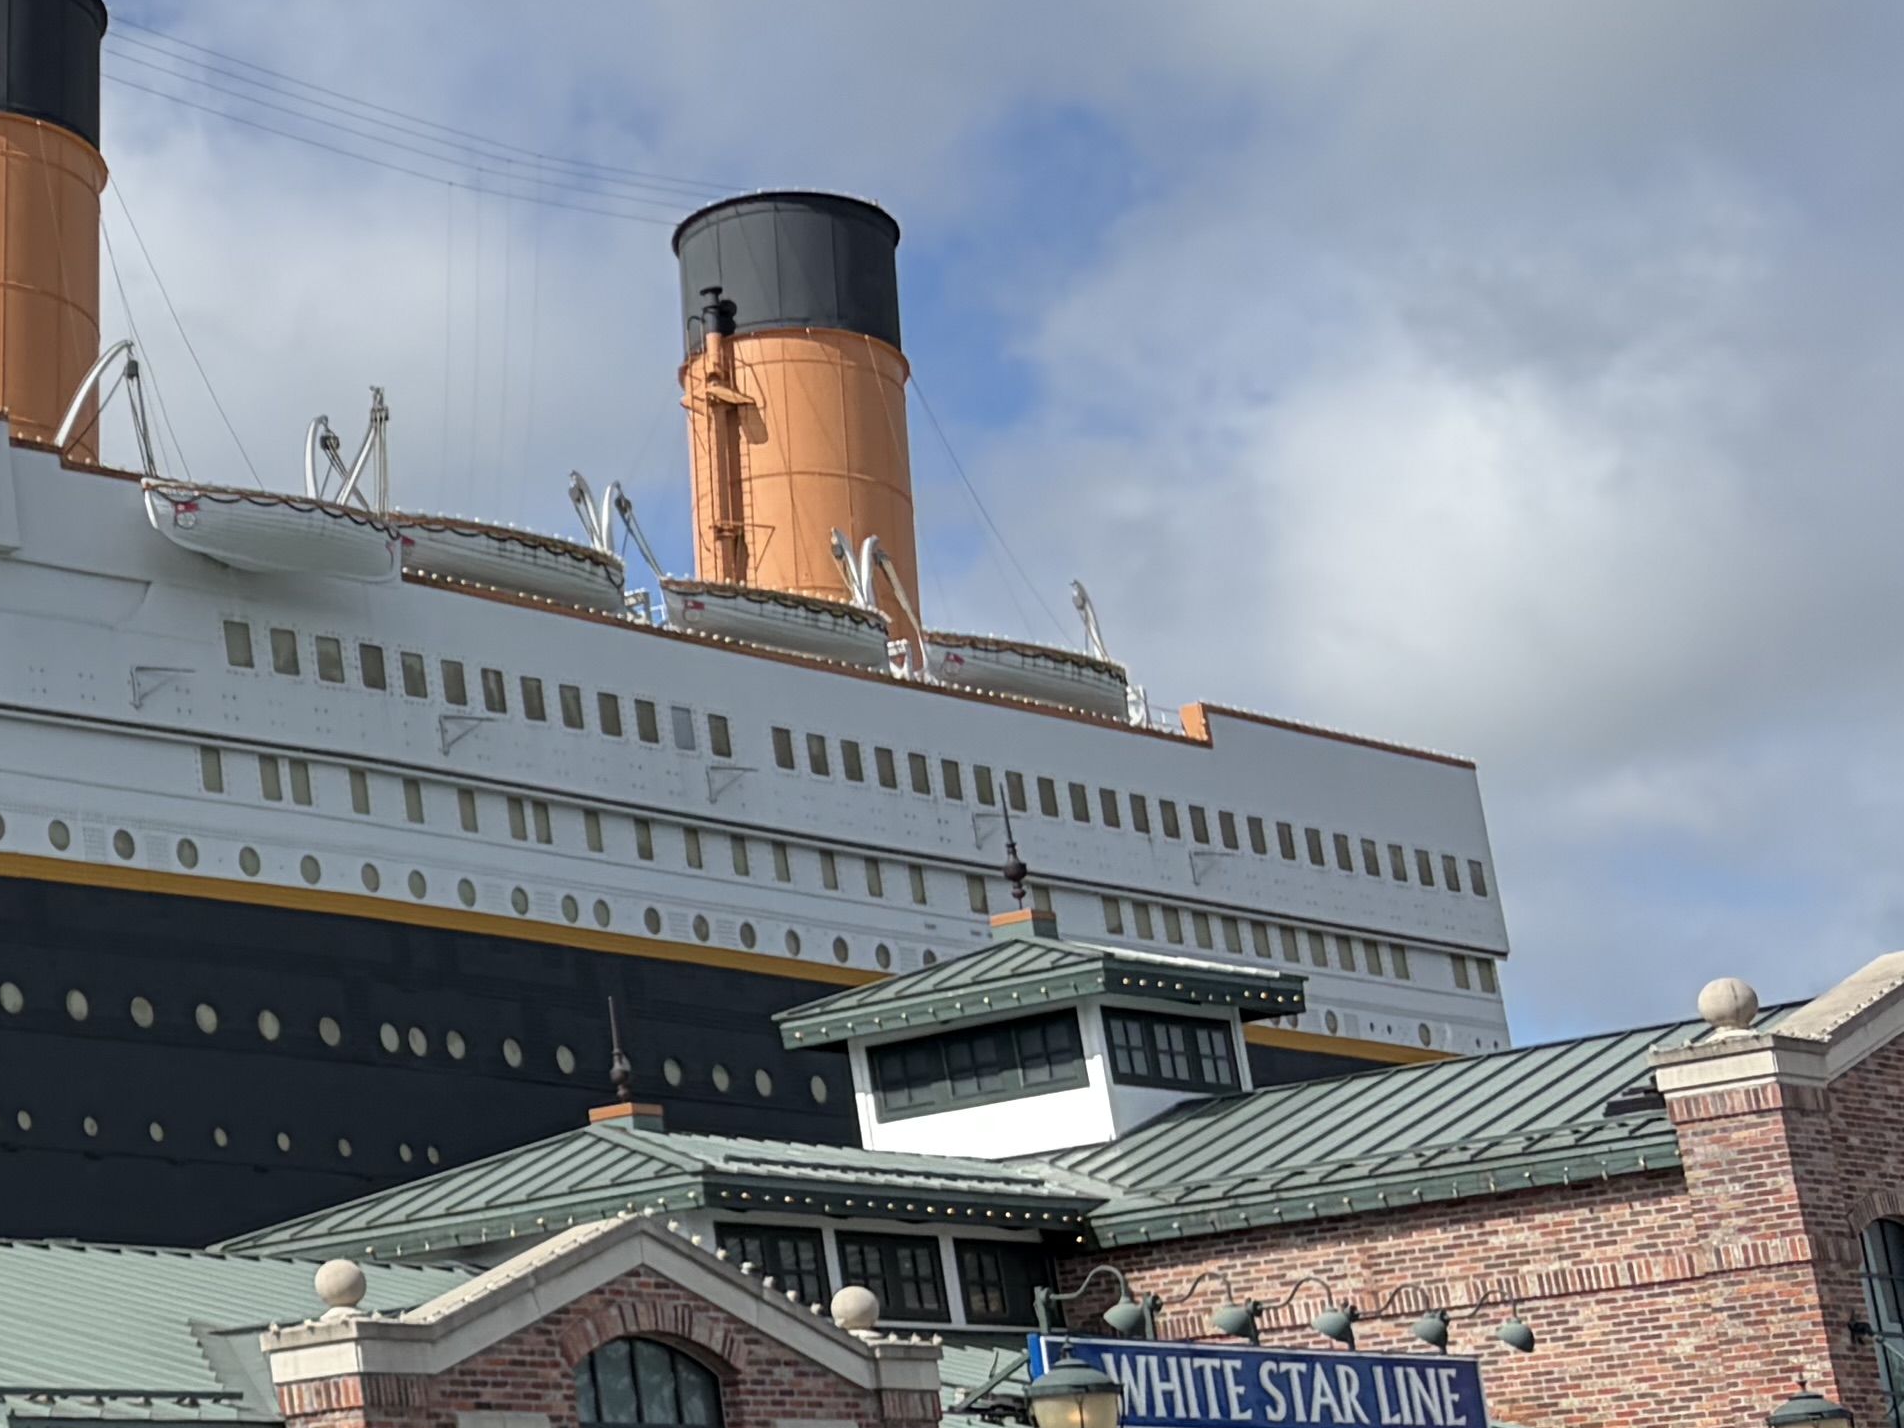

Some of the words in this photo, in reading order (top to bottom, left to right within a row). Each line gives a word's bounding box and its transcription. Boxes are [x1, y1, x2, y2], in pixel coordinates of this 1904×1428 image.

[1100, 1352, 1253, 1421] WHITE
[1258, 1359, 1370, 1425] STAR
[1372, 1365, 1467, 1427] LINE
